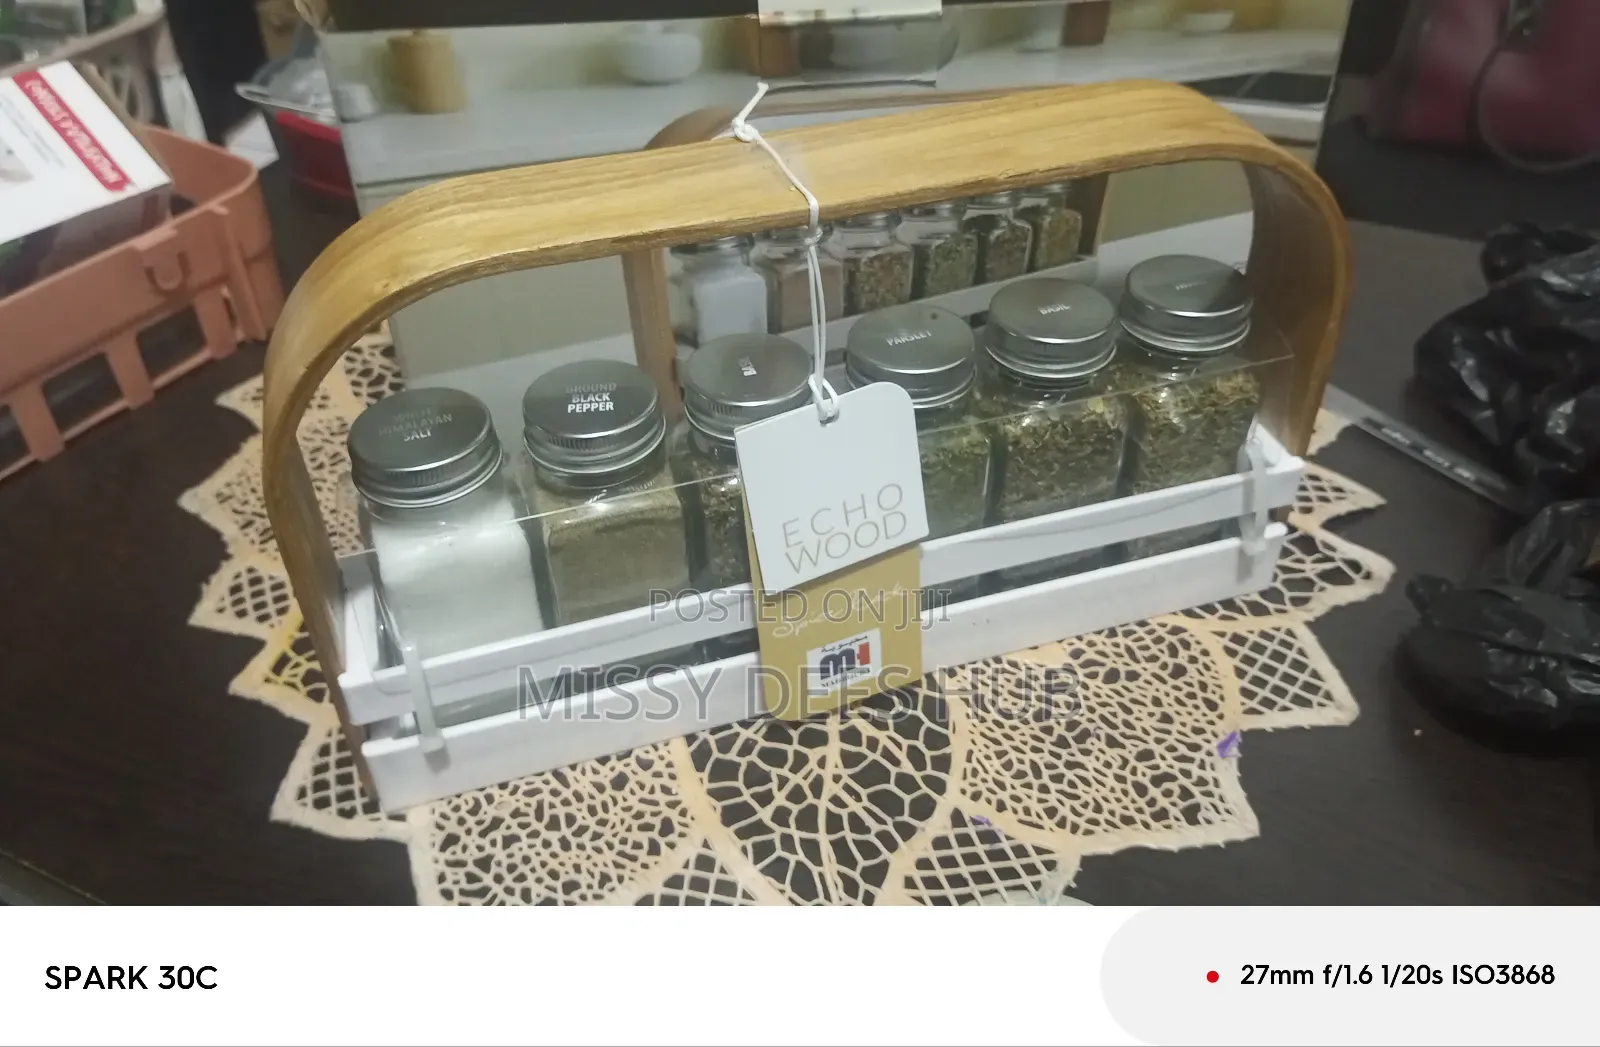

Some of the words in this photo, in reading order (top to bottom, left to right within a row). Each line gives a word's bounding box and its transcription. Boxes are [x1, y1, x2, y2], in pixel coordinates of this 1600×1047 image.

[565, 382, 617, 394] GROUND
[572, 392, 611, 403] BLACK
[567, 401, 615, 414] PEPPER
[378, 412, 453, 436] HIMALAYAN
[782, 483, 903, 548] ECHO
[785, 511, 907, 574] WOOD
